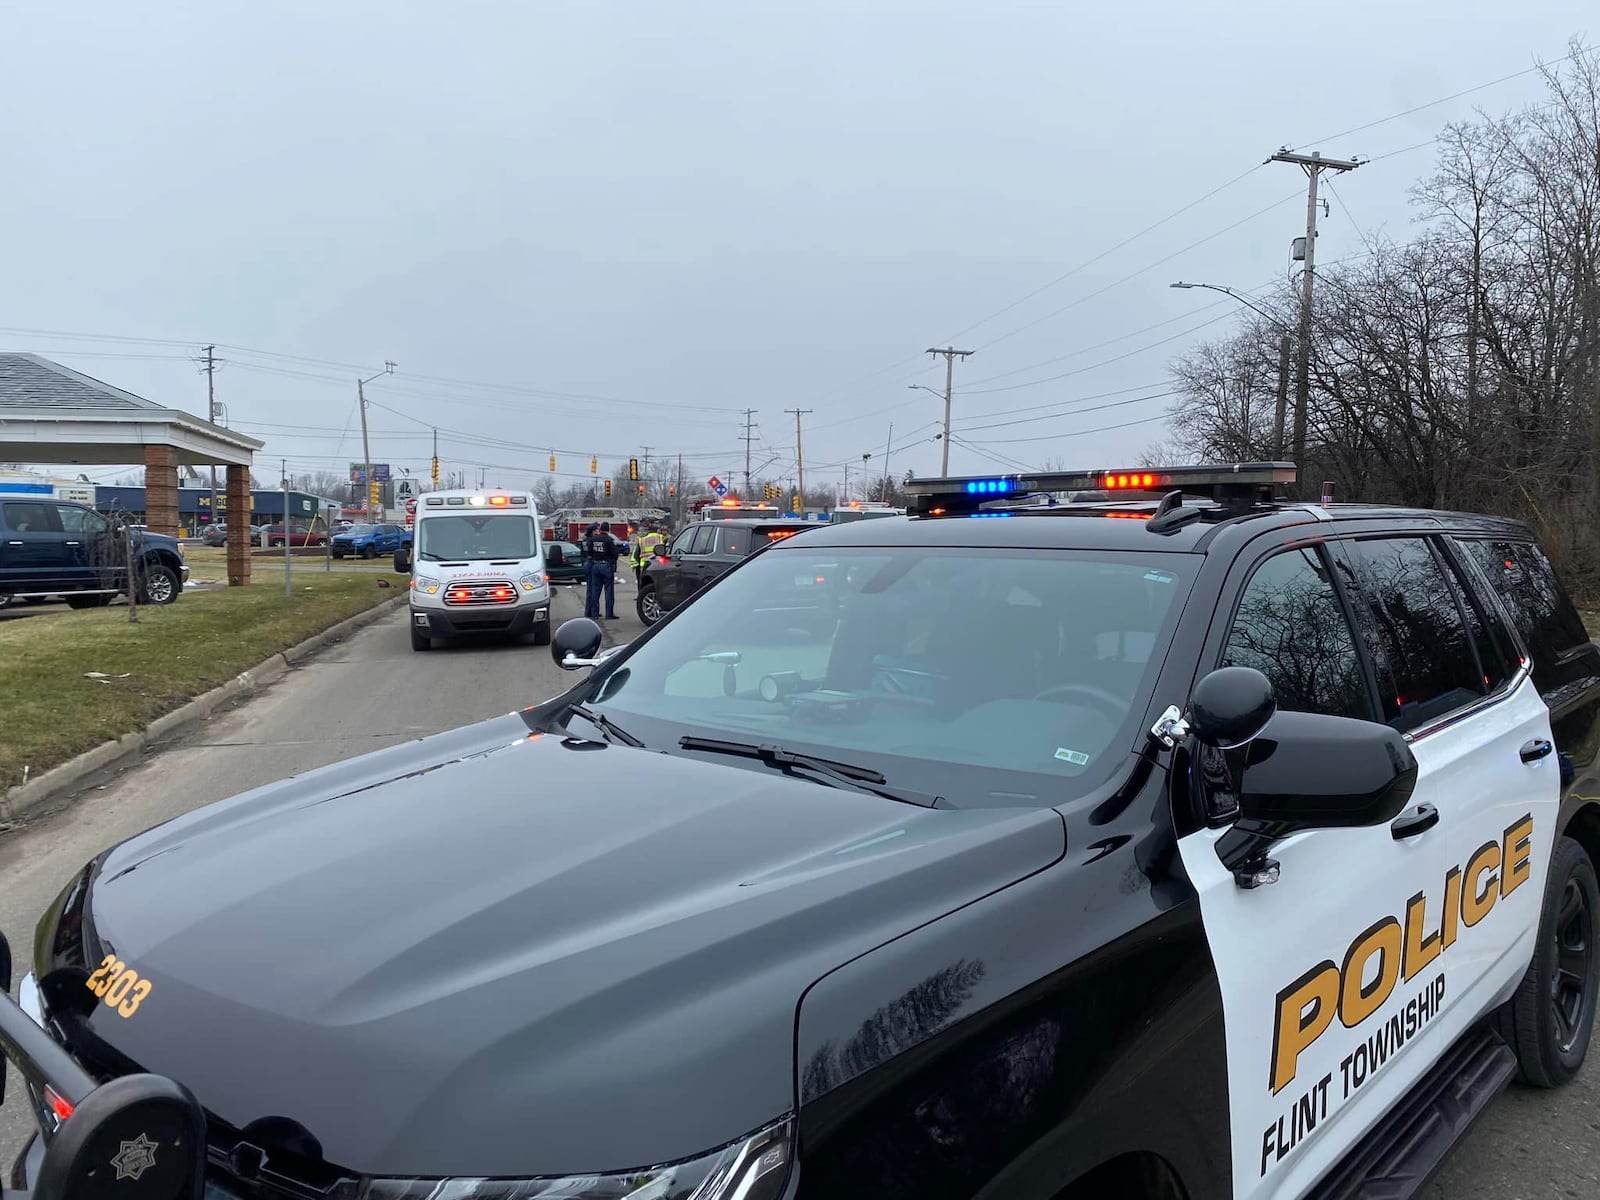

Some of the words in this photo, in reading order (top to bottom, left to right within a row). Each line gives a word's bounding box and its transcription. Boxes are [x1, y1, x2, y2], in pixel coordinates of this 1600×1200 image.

[86, 954, 152, 1018] 2303
[1269, 812, 1533, 1096] POLICE
[1261, 1072, 1332, 1178] FLINT
[1340, 972, 1446, 1100] TOWNSHIP
